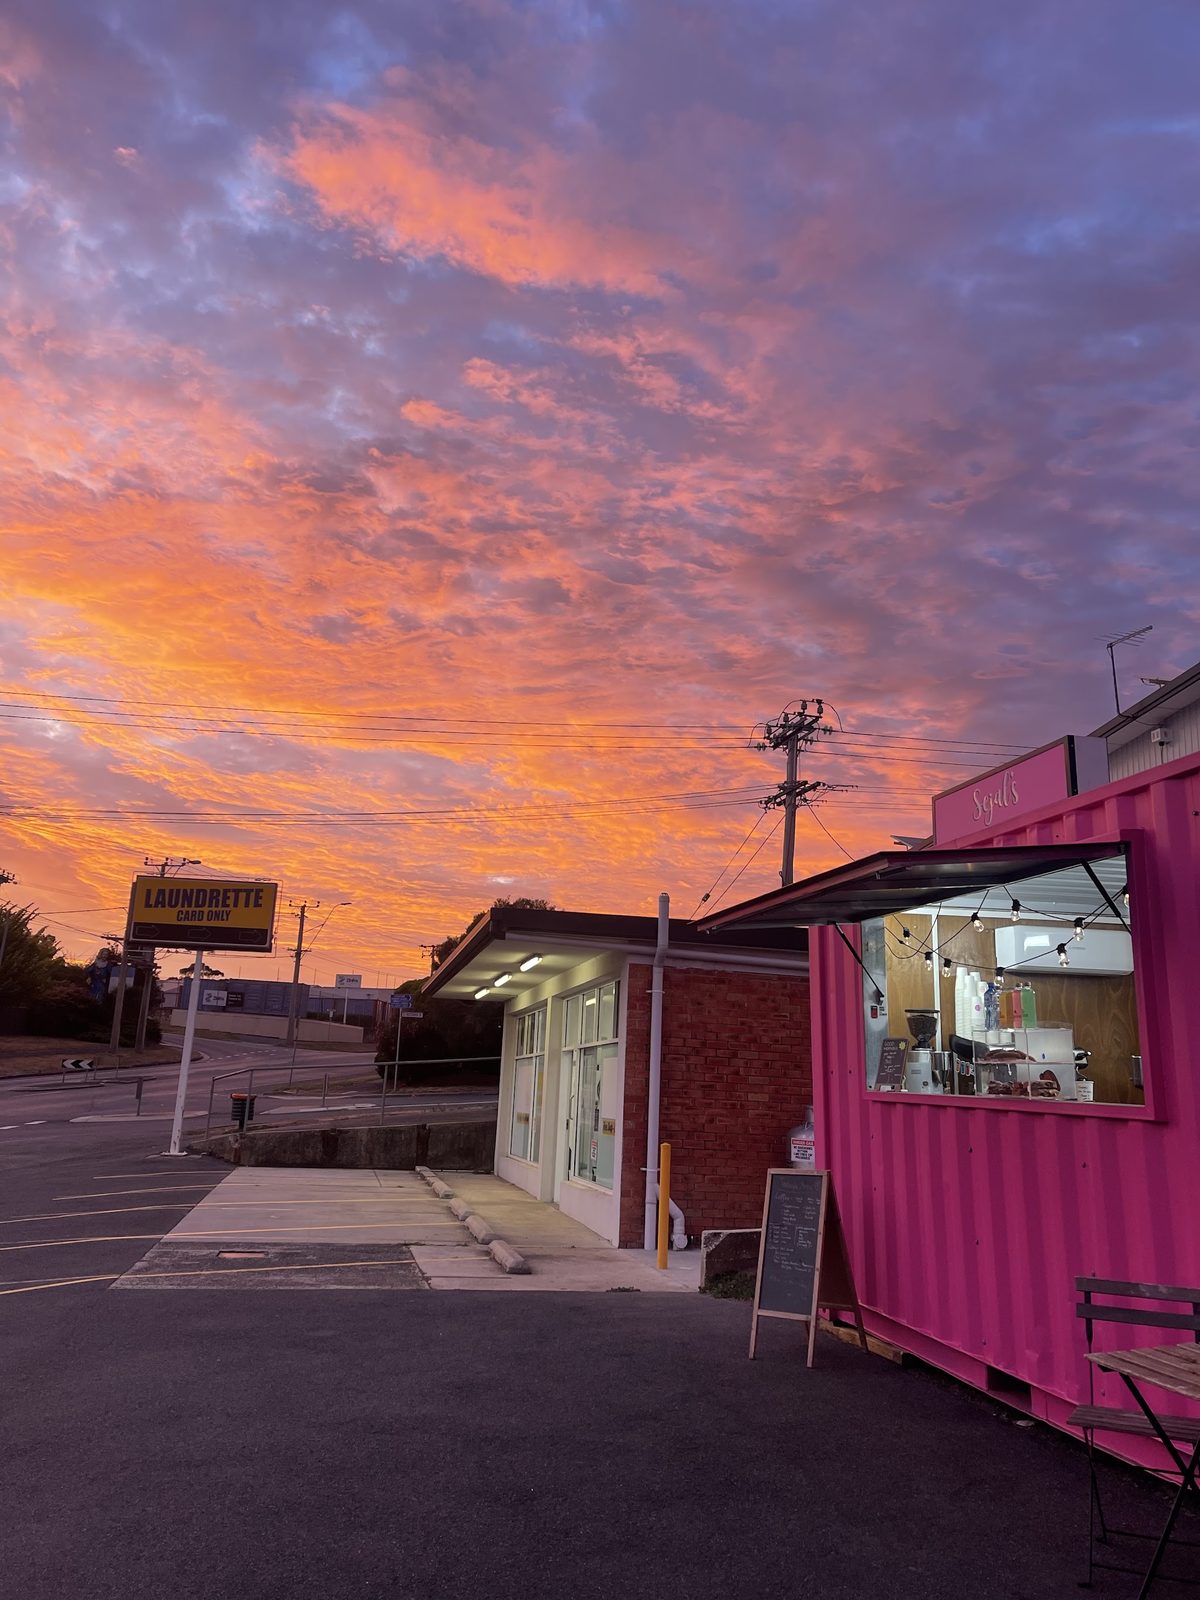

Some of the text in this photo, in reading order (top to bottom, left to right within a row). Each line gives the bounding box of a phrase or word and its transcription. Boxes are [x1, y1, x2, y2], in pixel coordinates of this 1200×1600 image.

[972, 769, 1020, 826] Sejal's
[144, 888, 264, 909] LAUNDRETTE
[176, 909, 231, 922] CARD ONLY
